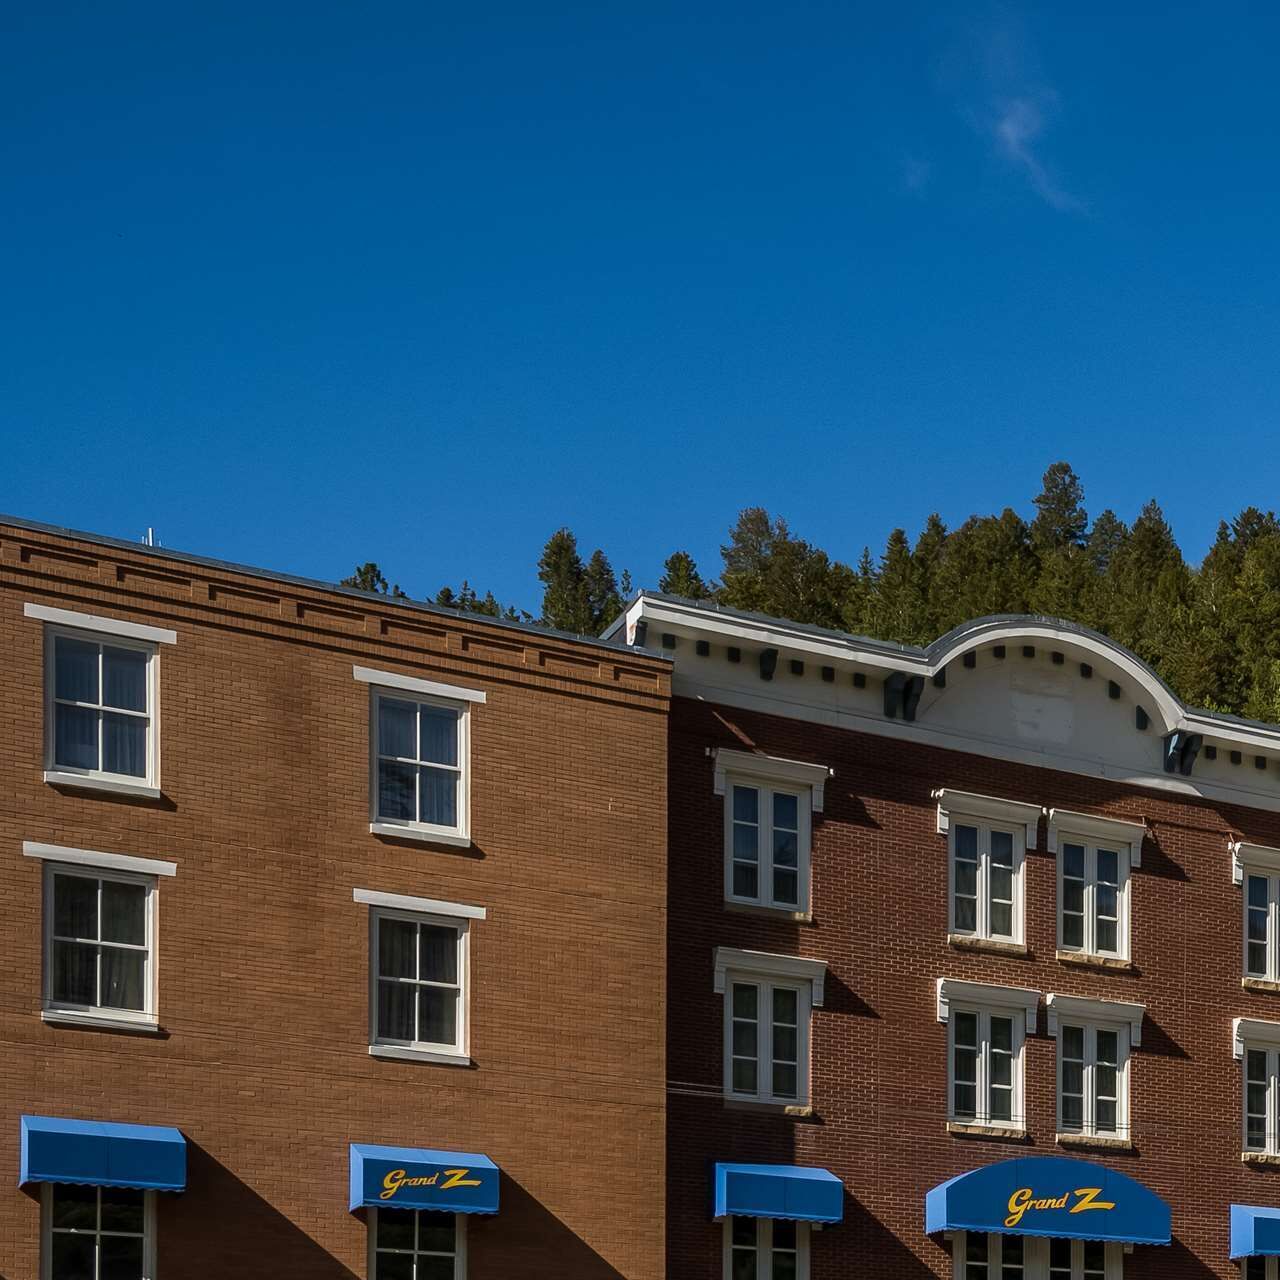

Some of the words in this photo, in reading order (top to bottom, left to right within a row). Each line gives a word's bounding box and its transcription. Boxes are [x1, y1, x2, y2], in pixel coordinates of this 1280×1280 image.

[379, 1169, 440, 1200] Grand
[439, 1169, 482, 1189] Z
[1004, 1188, 1070, 1227] Grand
[1069, 1188, 1116, 1214] Z
